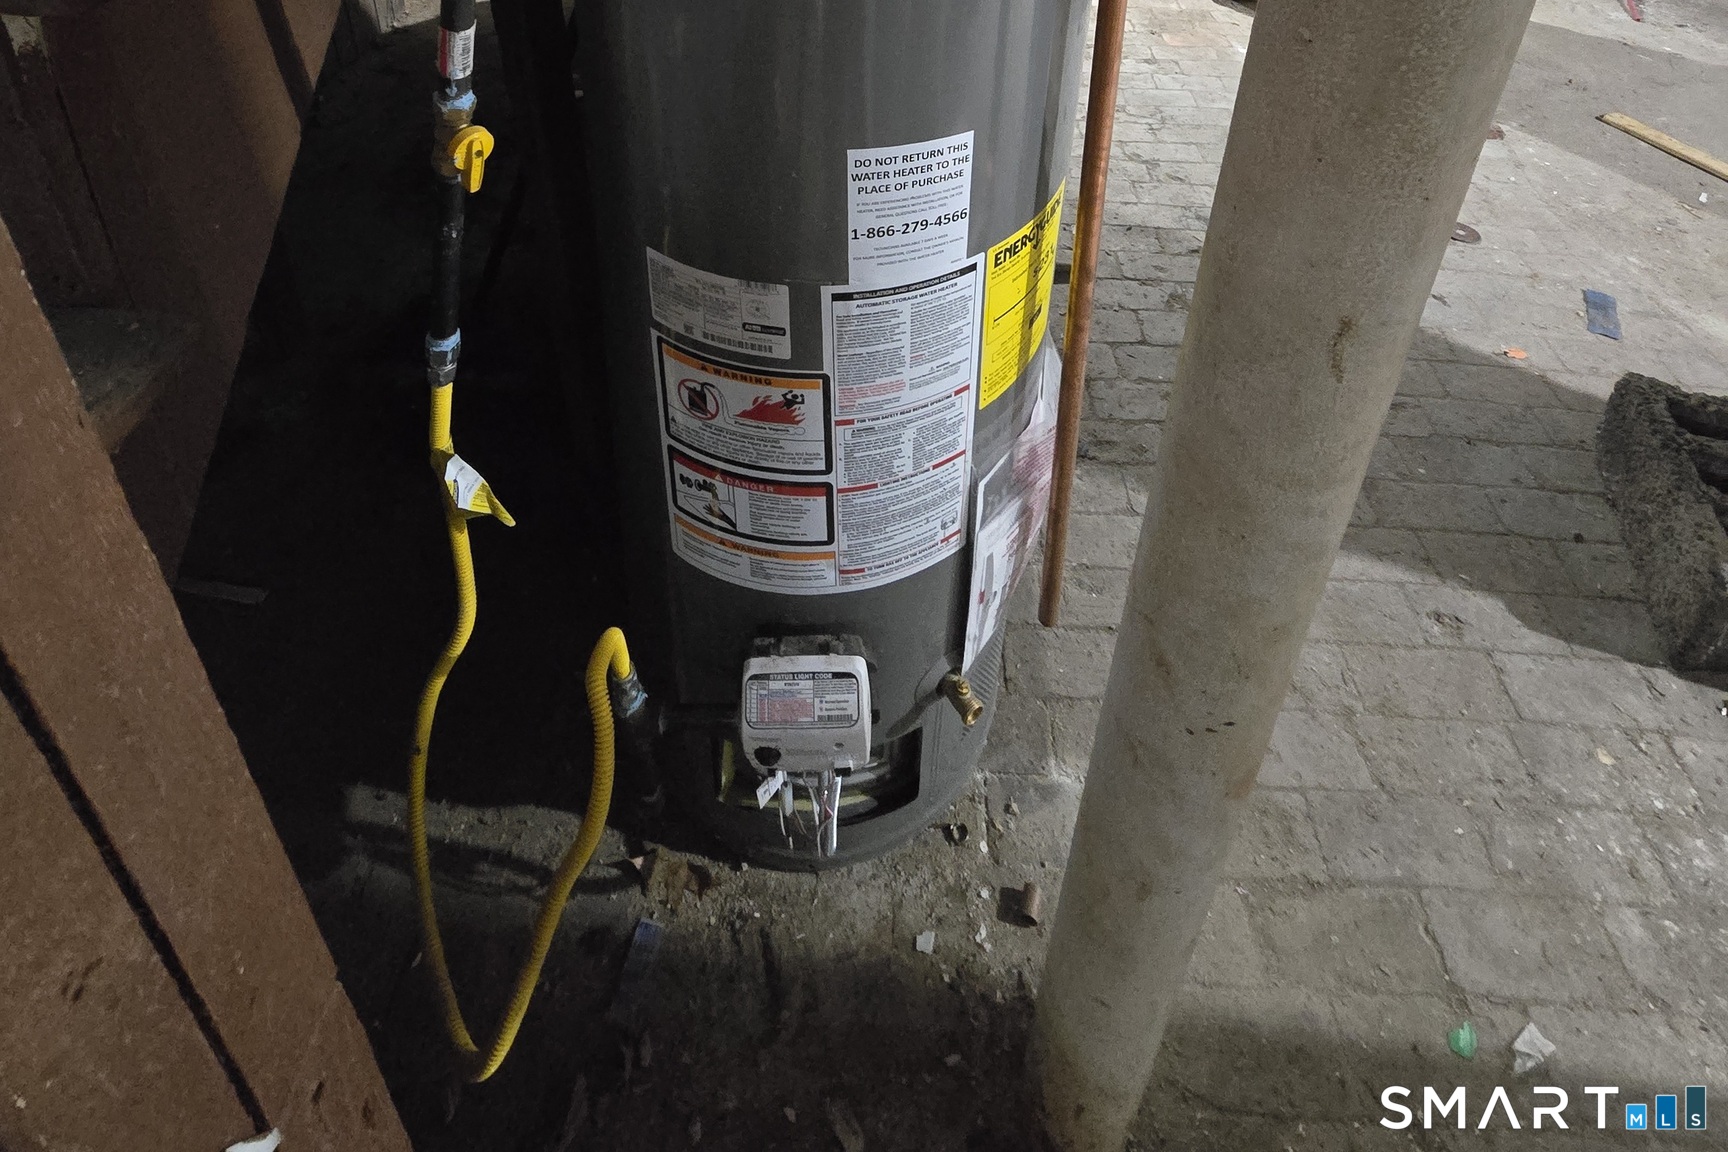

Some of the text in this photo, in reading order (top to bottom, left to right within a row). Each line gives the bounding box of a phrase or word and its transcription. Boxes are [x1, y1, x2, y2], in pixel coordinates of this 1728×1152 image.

[851, 154, 970, 182] WATER HEATER TO THE
[854, 142, 968, 168] DO NOT RETURN THIS
[858, 169, 964, 195] PLACE OF PURCHASE
[851, 208, 968, 240] 1-866-279-4566
[853, 289, 895, 299] INSTALLATION
[908, 278, 940, 291] OPERATION
[940, 271, 961, 283] DETAILS
[856, 282, 958, 309] AUTOMATIC STORAGE WATER HEATER
[713, 368, 773, 386] WARNING
[912, 403, 929, 412] BEFORE
[930, 394, 952, 406] OPERATING
[734, 420, 767, 431] Flammable
[726, 477, 774, 493] DANGER
[731, 543, 780, 558] WARNING
